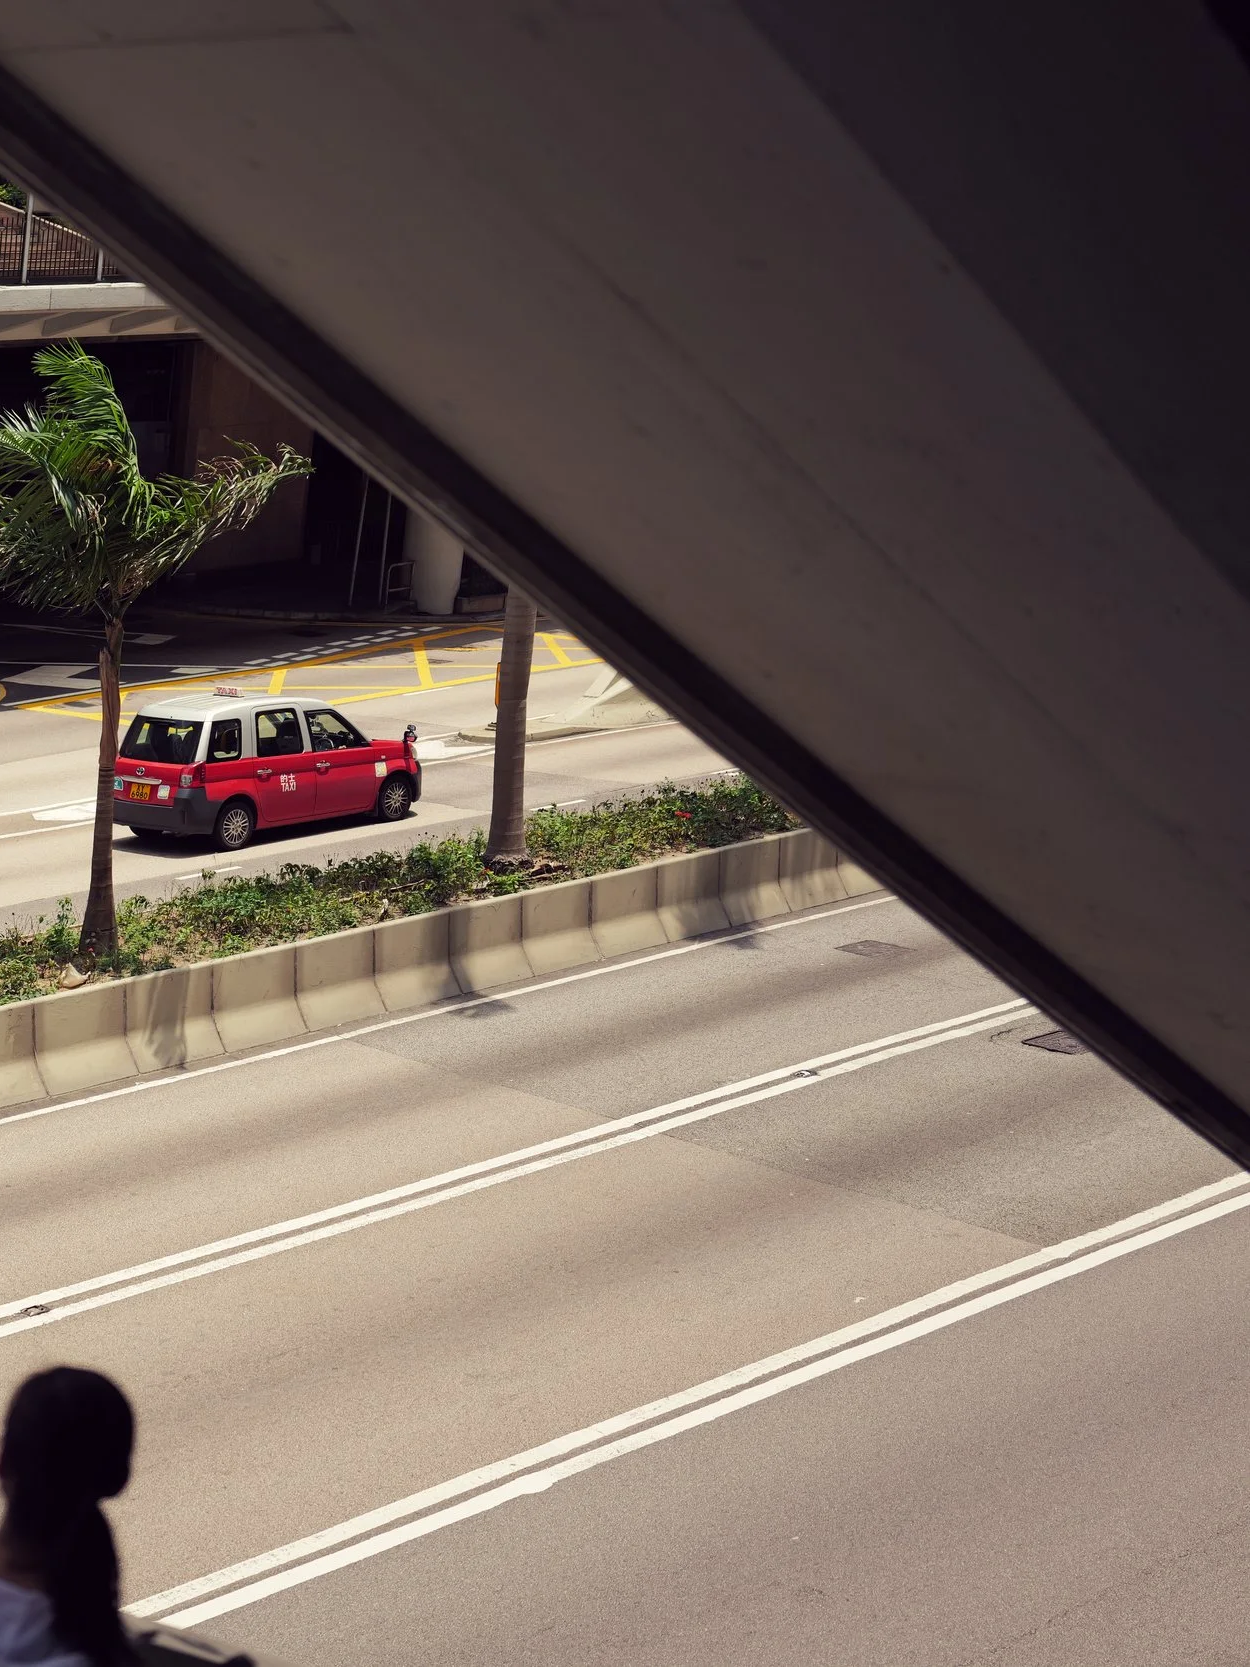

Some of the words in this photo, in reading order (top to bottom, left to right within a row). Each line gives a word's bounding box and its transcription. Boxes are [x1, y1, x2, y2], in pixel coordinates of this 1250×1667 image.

[216, 687, 237, 695] TAXI
[280, 773, 296, 782] 的士
[281, 781, 296, 792] TAXI
[131, 791, 148, 799] 6980
